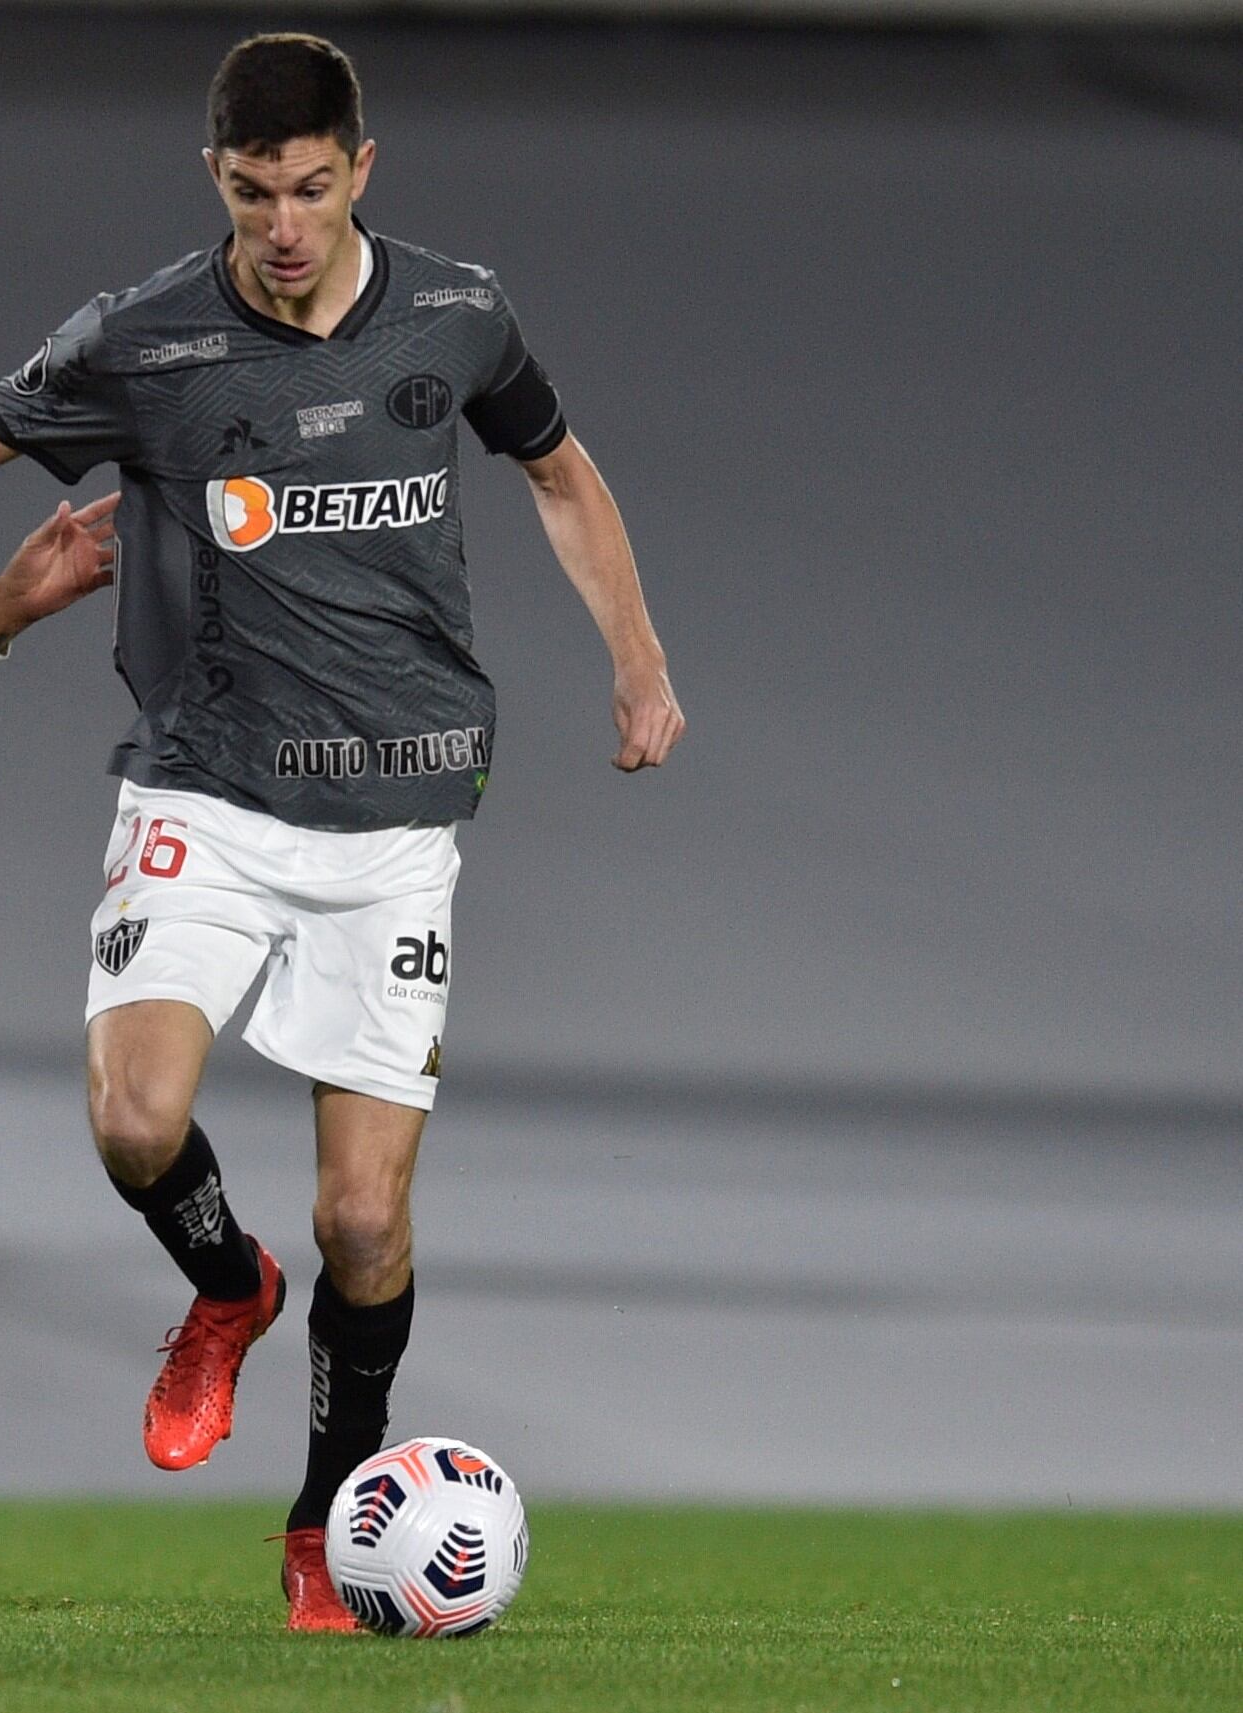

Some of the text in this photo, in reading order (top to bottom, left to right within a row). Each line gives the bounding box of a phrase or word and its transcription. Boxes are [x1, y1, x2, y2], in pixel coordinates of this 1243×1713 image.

[276, 727, 488, 779] AUTO TRUCK
[390, 930, 448, 986] ab
